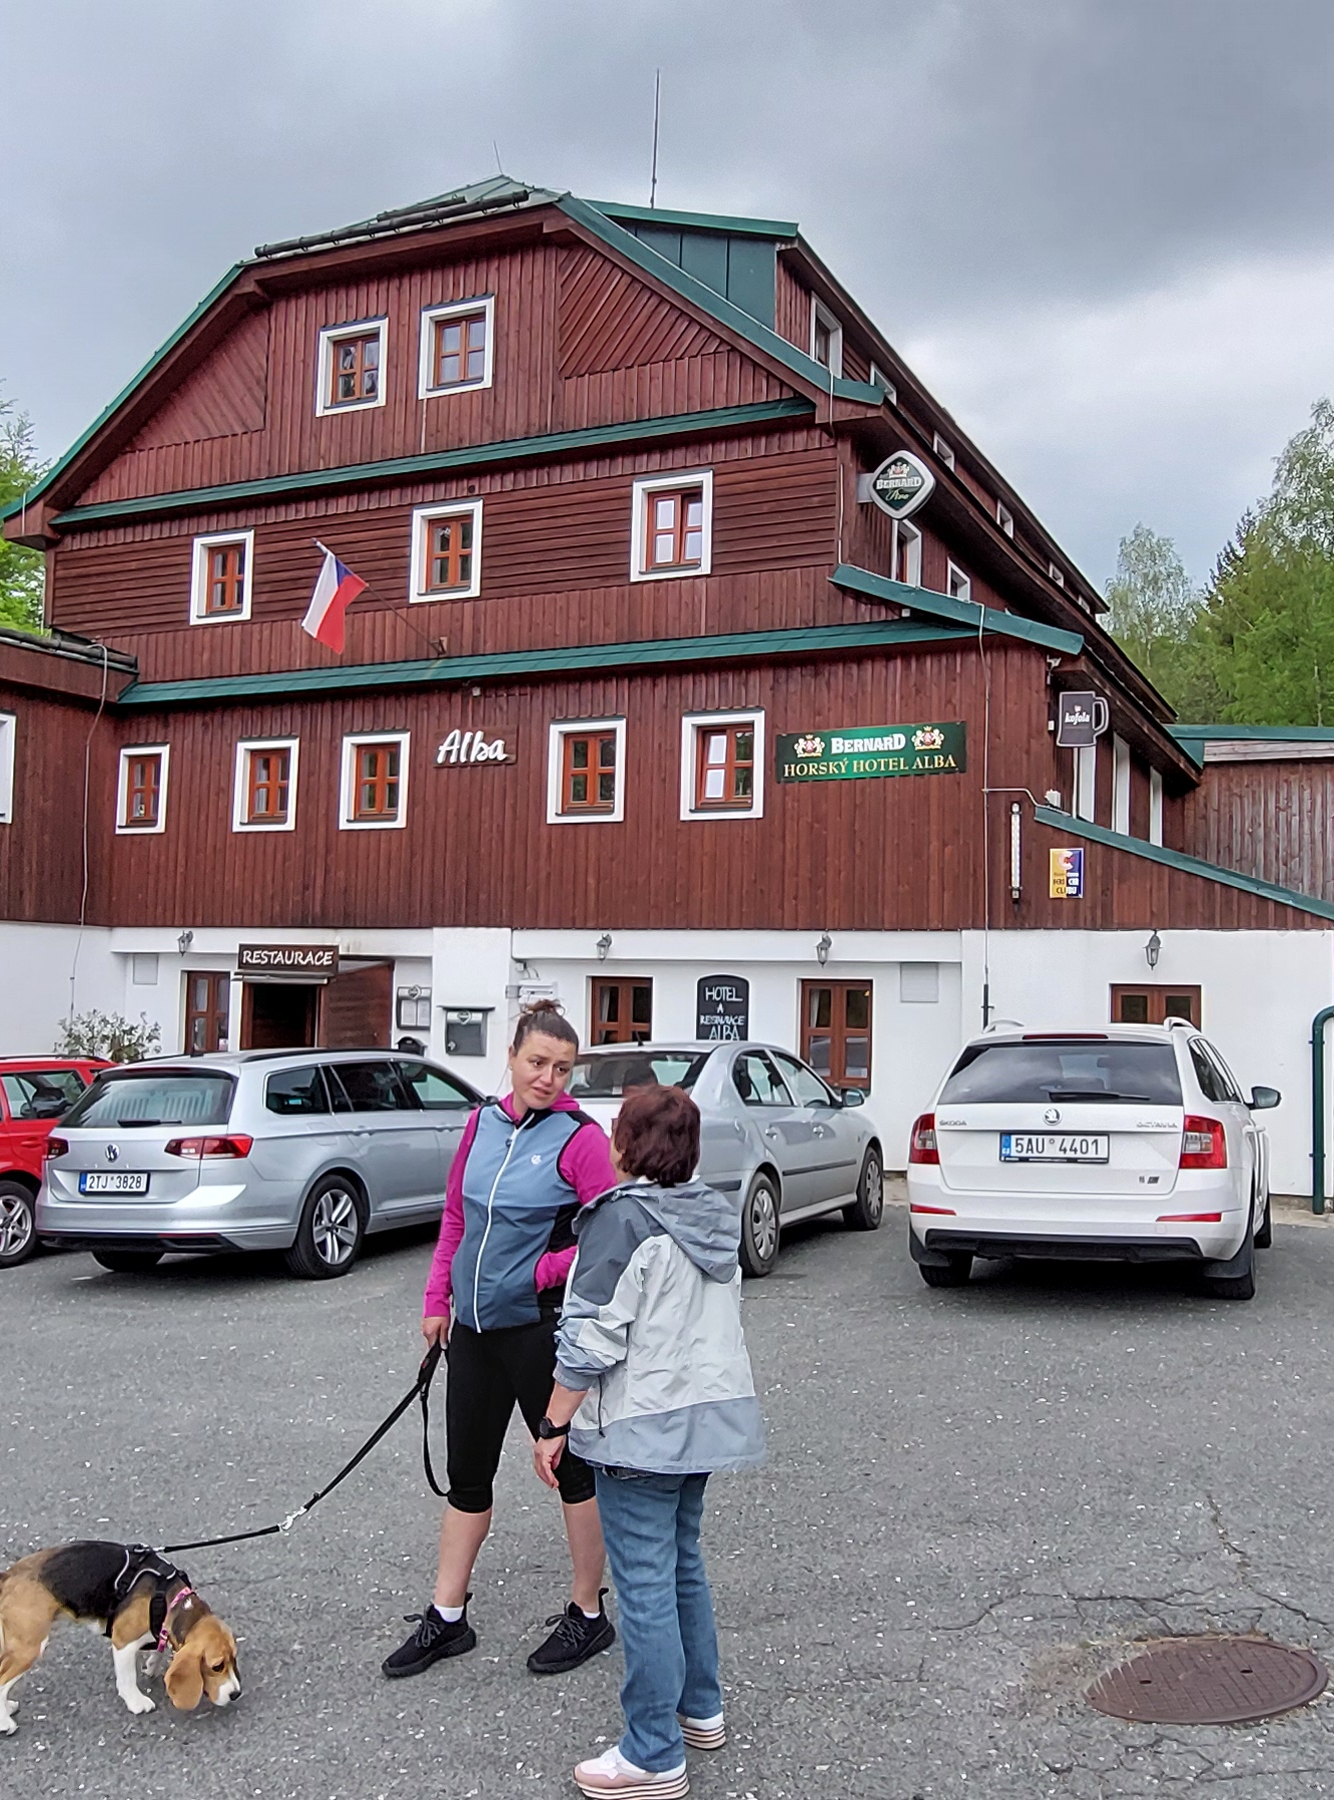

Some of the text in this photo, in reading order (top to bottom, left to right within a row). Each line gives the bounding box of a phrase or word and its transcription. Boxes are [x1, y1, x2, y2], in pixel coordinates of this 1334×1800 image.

[876, 476, 922, 490] BERNARD
[1064, 711, 1091, 726] kofola
[437, 728, 508, 764] Alba
[830, 733, 907, 755] BERNARD
[783, 754, 958, 778] HORSKÝ HOTEL ALBA
[242, 950, 334, 966] RESTAURACE
[705, 986, 744, 1001] HOTEL
[716, 1002, 724, 1014] A
[1015, 1137, 1045, 1154] 5AU
[1058, 1138, 1099, 1155] 4401
[88, 1175, 142, 1189] 2TJ 3828
